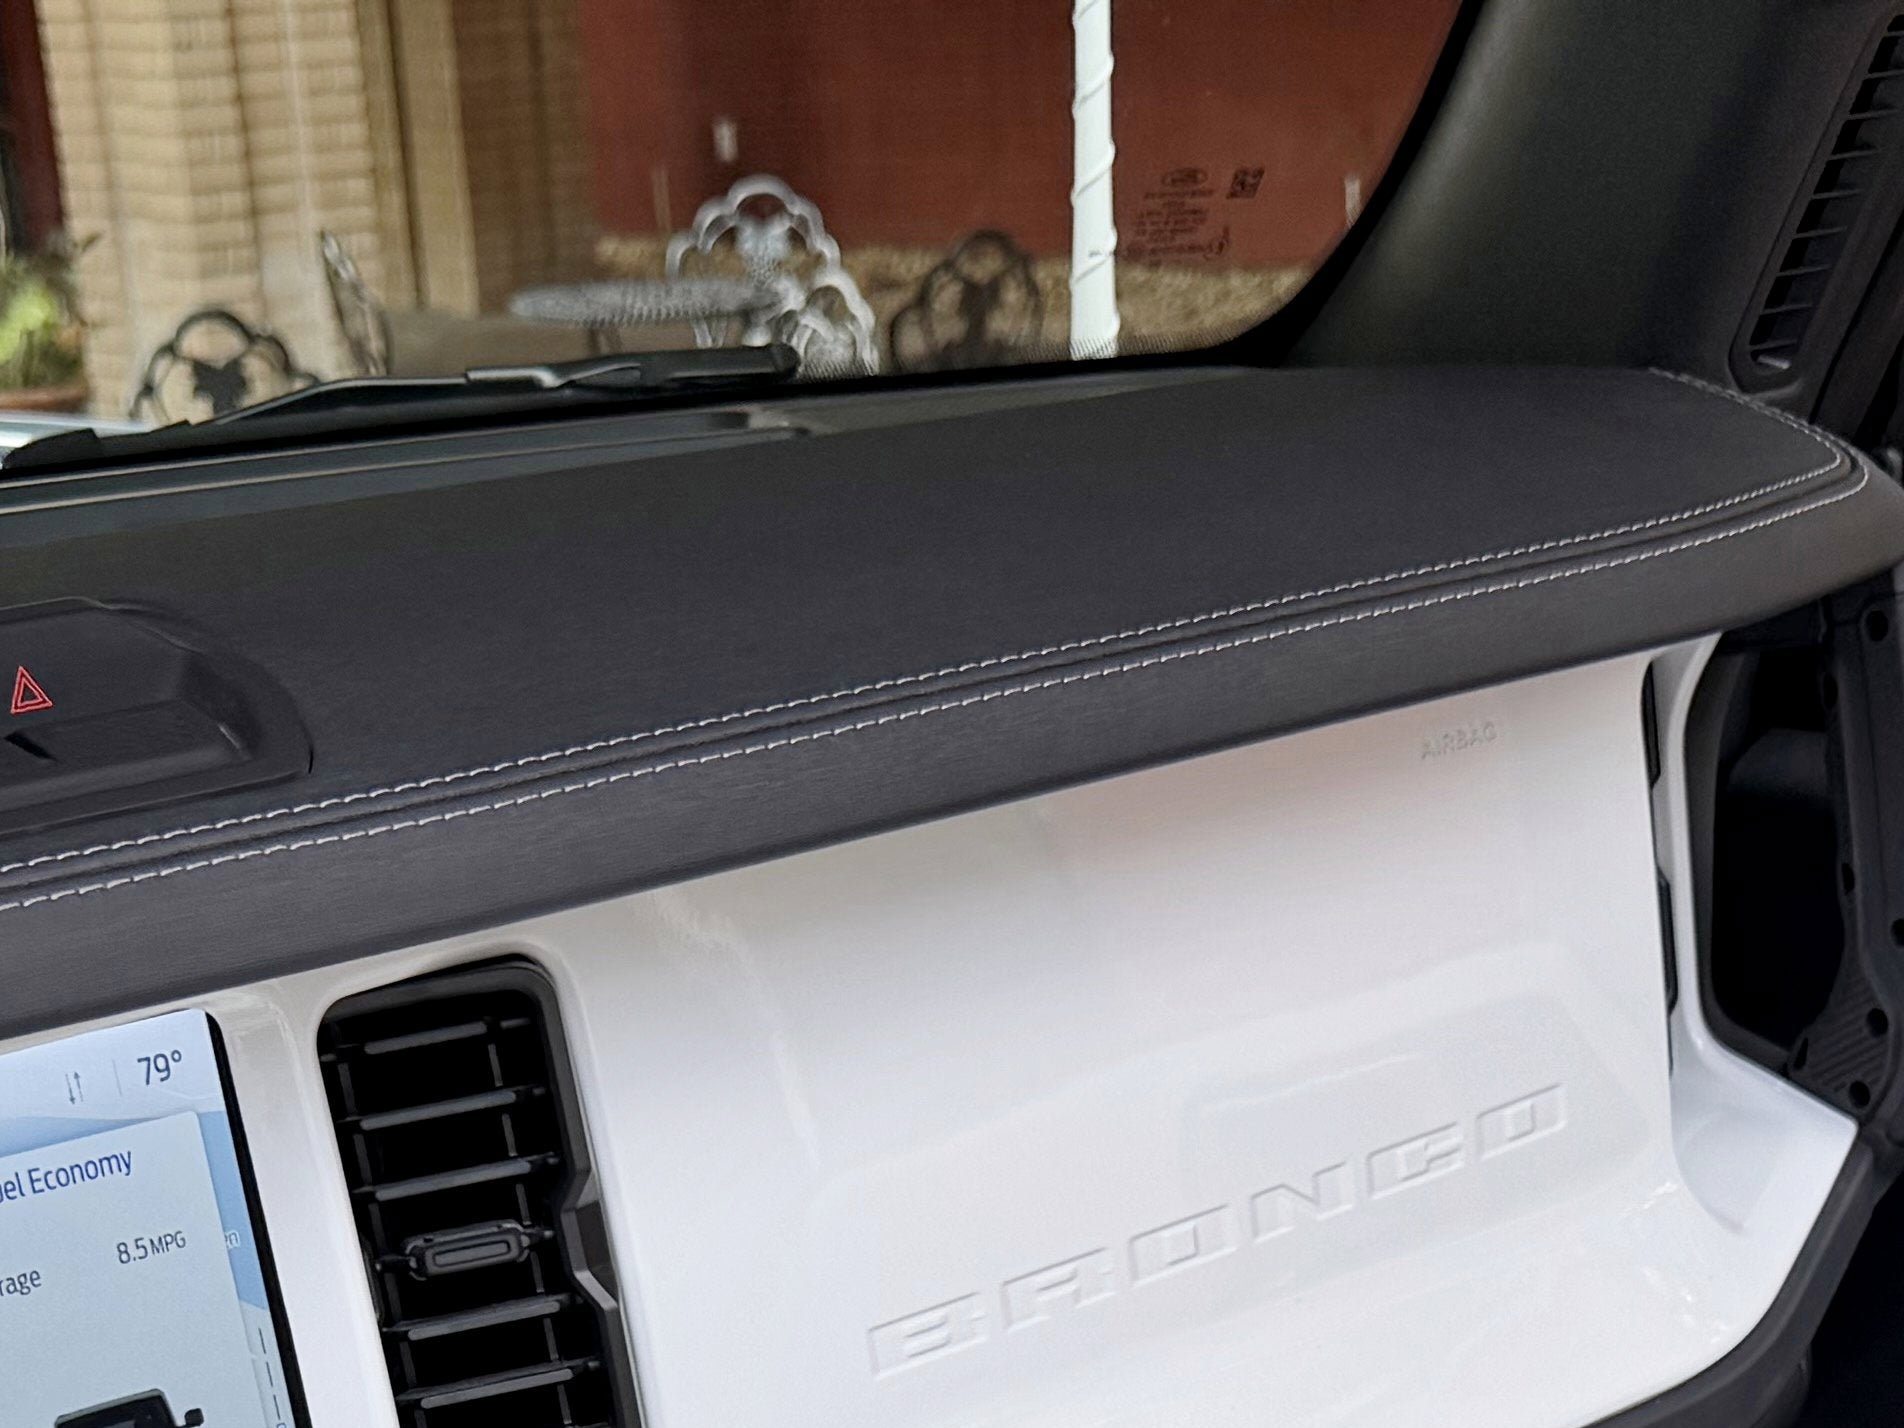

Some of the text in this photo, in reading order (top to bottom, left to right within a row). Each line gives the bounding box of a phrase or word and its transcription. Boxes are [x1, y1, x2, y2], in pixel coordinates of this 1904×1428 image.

[137, 1049, 183, 1088] 79°
[29, 1149, 133, 1196] Economy
[866, 1083, 1568, 1380] BRONCO
